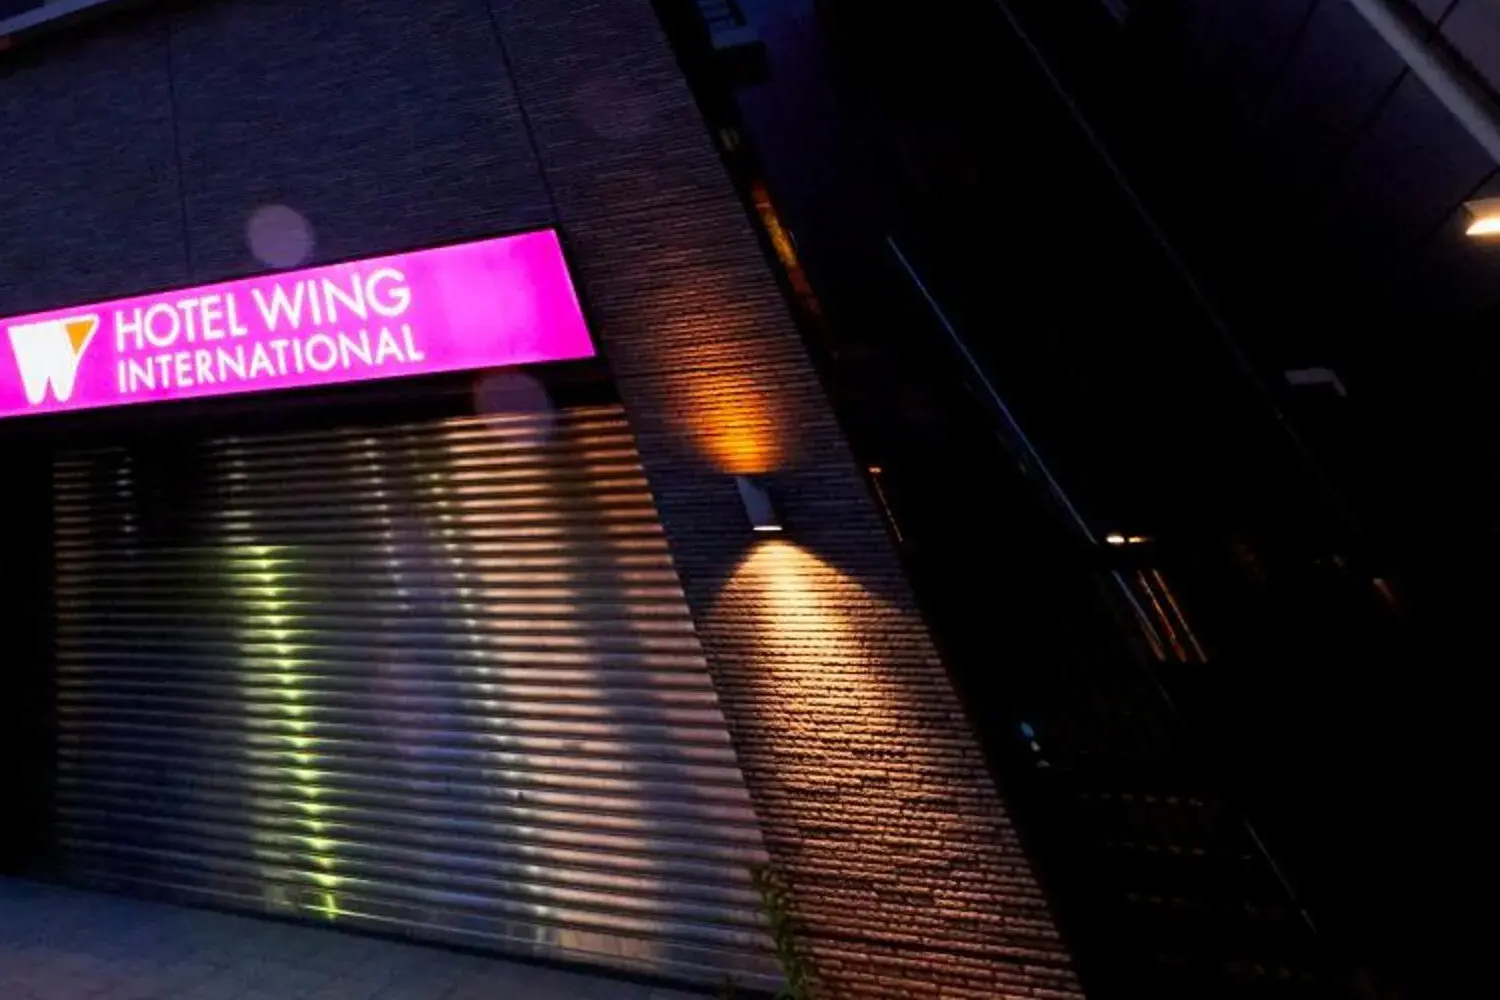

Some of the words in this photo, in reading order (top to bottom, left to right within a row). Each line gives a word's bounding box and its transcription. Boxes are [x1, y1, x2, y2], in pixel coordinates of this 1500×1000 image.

[113, 295, 241, 354] HOTEL
[248, 267, 413, 336] WING
[116, 324, 425, 395] INTERNATIONAL
